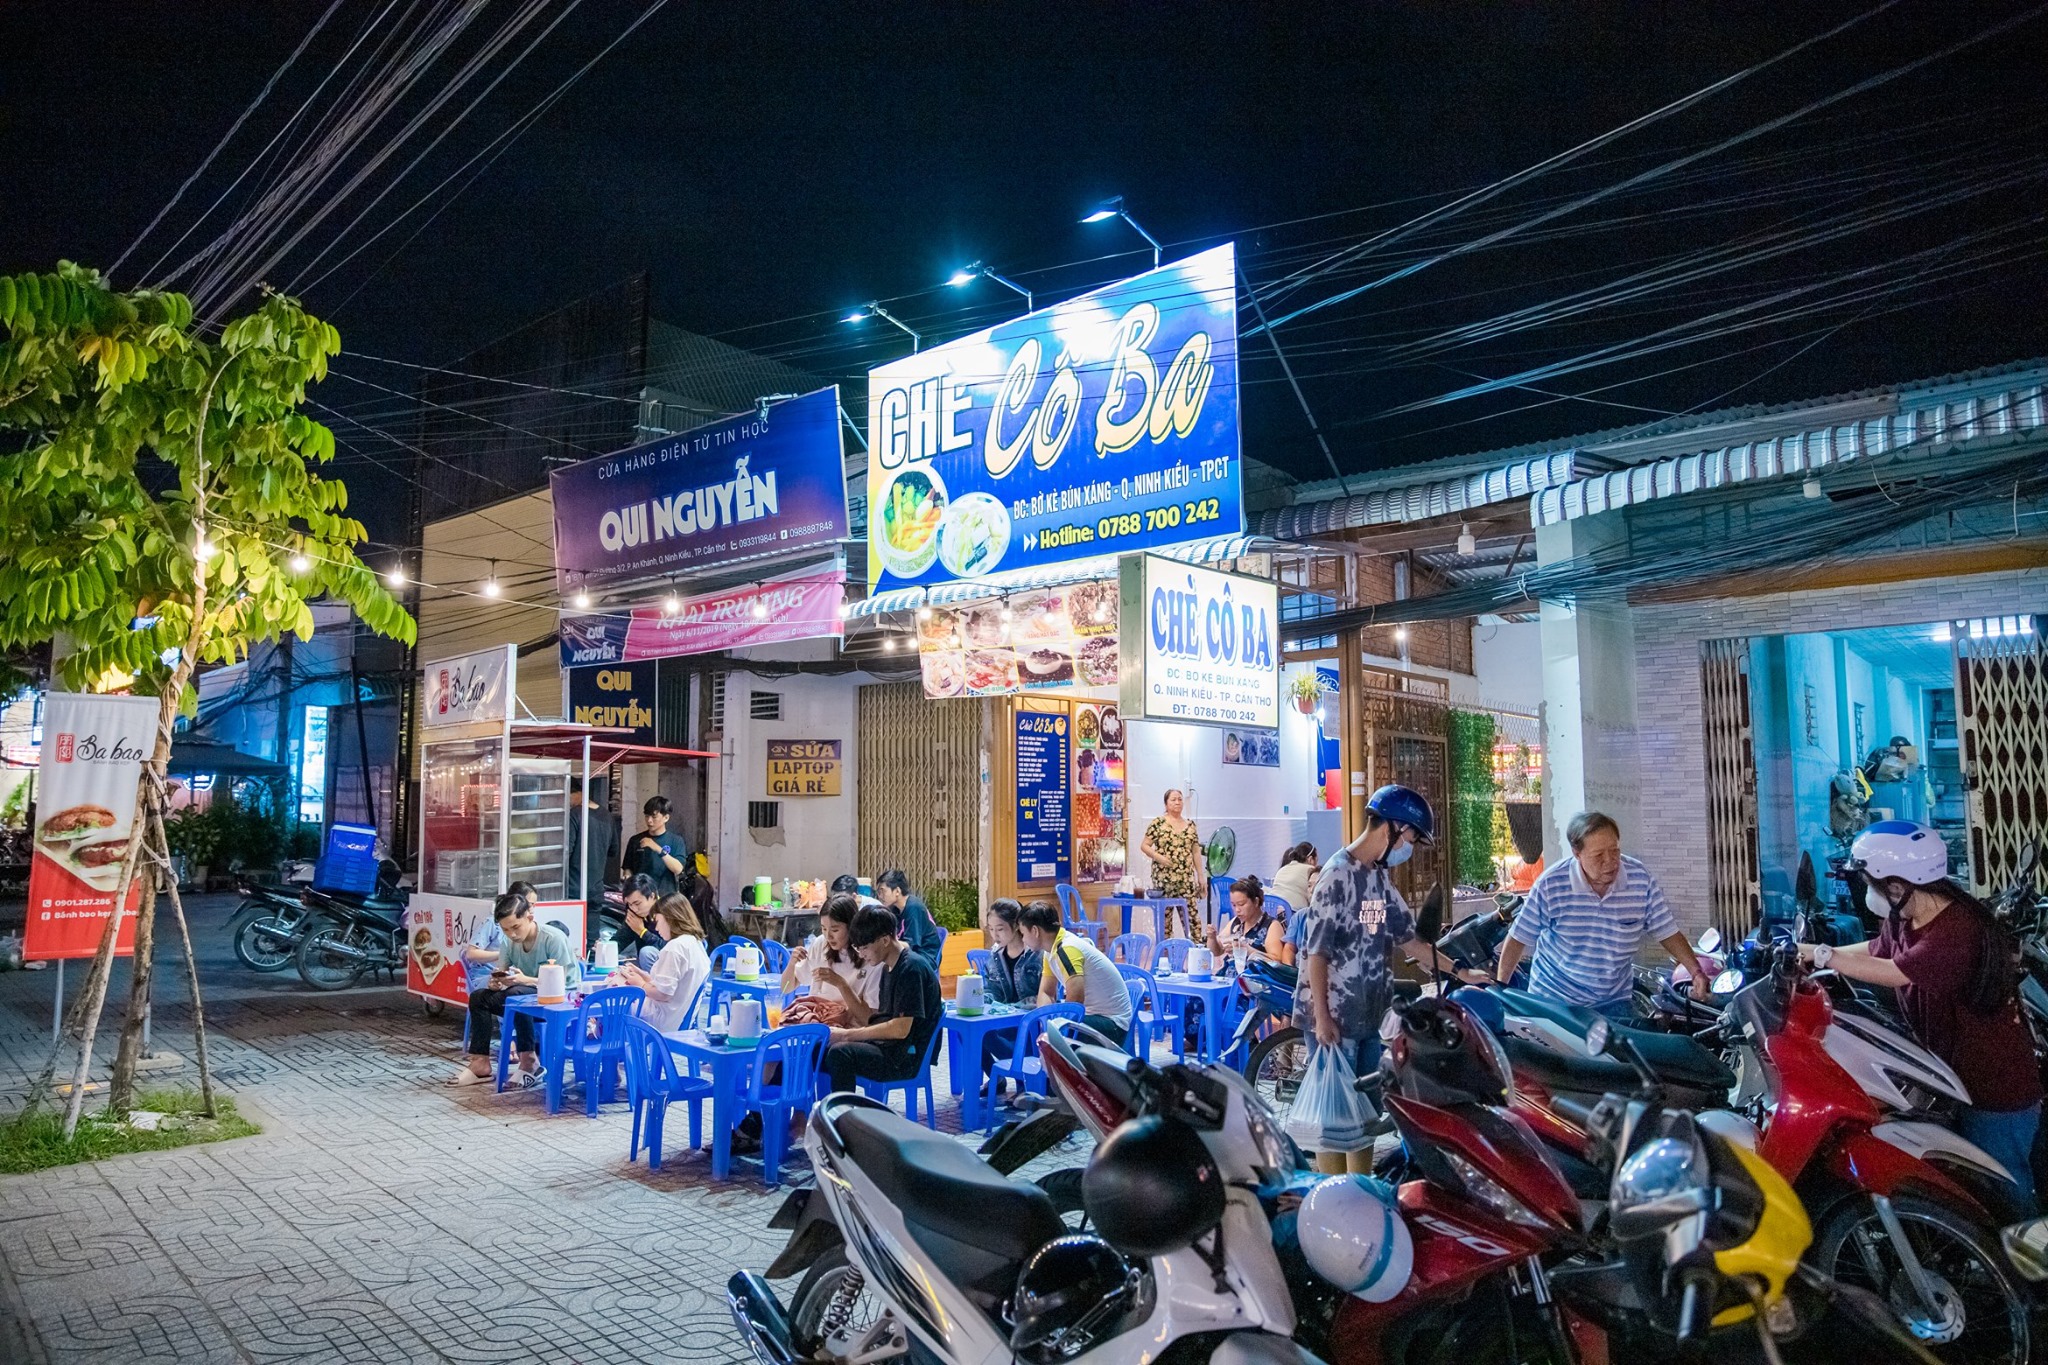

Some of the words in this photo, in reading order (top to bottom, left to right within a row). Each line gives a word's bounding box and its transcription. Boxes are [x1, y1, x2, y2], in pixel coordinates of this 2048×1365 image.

[984, 337, 1083, 480] Cô
[1094, 302, 1214, 459] Ba
[599, 462, 621, 480] CỬA
[625, 452, 656, 473] HÀNG
[661, 442, 689, 462] ĐIỆN
[694, 434, 710, 451] TỬ
[715, 429, 736, 447] TIN
[742, 419, 769, 439] HỌC
[1013, 498, 1029, 520] ĐC:
[1031, 490, 1044, 516] BỜ
[1046, 488, 1059, 513] KÈ
[1061, 484, 1081, 510] BÚN
[1084, 479, 1111, 505] XÁNG
[1121, 477, 1132, 500] Q.
[1134, 470, 1161, 496] NINH
[1200, 455, 1229, 482] TPCT
[600, 503, 649, 552] QUI
[653, 455, 778, 541] NGUYỄN
[1039, 524, 1095, 549] Hotline:
[1098, 512, 1141, 539] 0788
[1145, 505, 1181, 531] 700
[1185, 498, 1219, 524] 242
[665, 552, 678, 563] Ninh
[739, 532, 777, 548] 0933119844
[789, 521, 833, 538] 0988887848
[586, 626, 605, 640] QUI
[1152, 574, 1202, 662] CHÈ
[1205, 581, 1238, 667] CÔ
[1241, 604, 1274, 672] BA
[572, 641, 616, 662] NGUYỄN
[596, 669, 632, 691] QUI
[1166, 685, 1189, 698] NINH
[575, 698, 652, 728] NGUYỄN
[1172, 703, 1191, 715] ĐT:
[1193, 706, 1217, 718] 0788
[1220, 708, 1237, 720] 700
[1239, 711, 1256, 722] 242
[76, 734, 108, 761] Ba
[110, 736, 143, 760] bao
[790, 740, 835, 758] SỬA
[773, 761, 835, 775] LAPTOP
[773, 776, 801, 793] GIÁ
[806, 776, 827, 793] RẺ
[54, 910, 78, 919] Bánh
[79, 909, 96, 918] bao
[1414, 1214, 1511, 1256] 150
